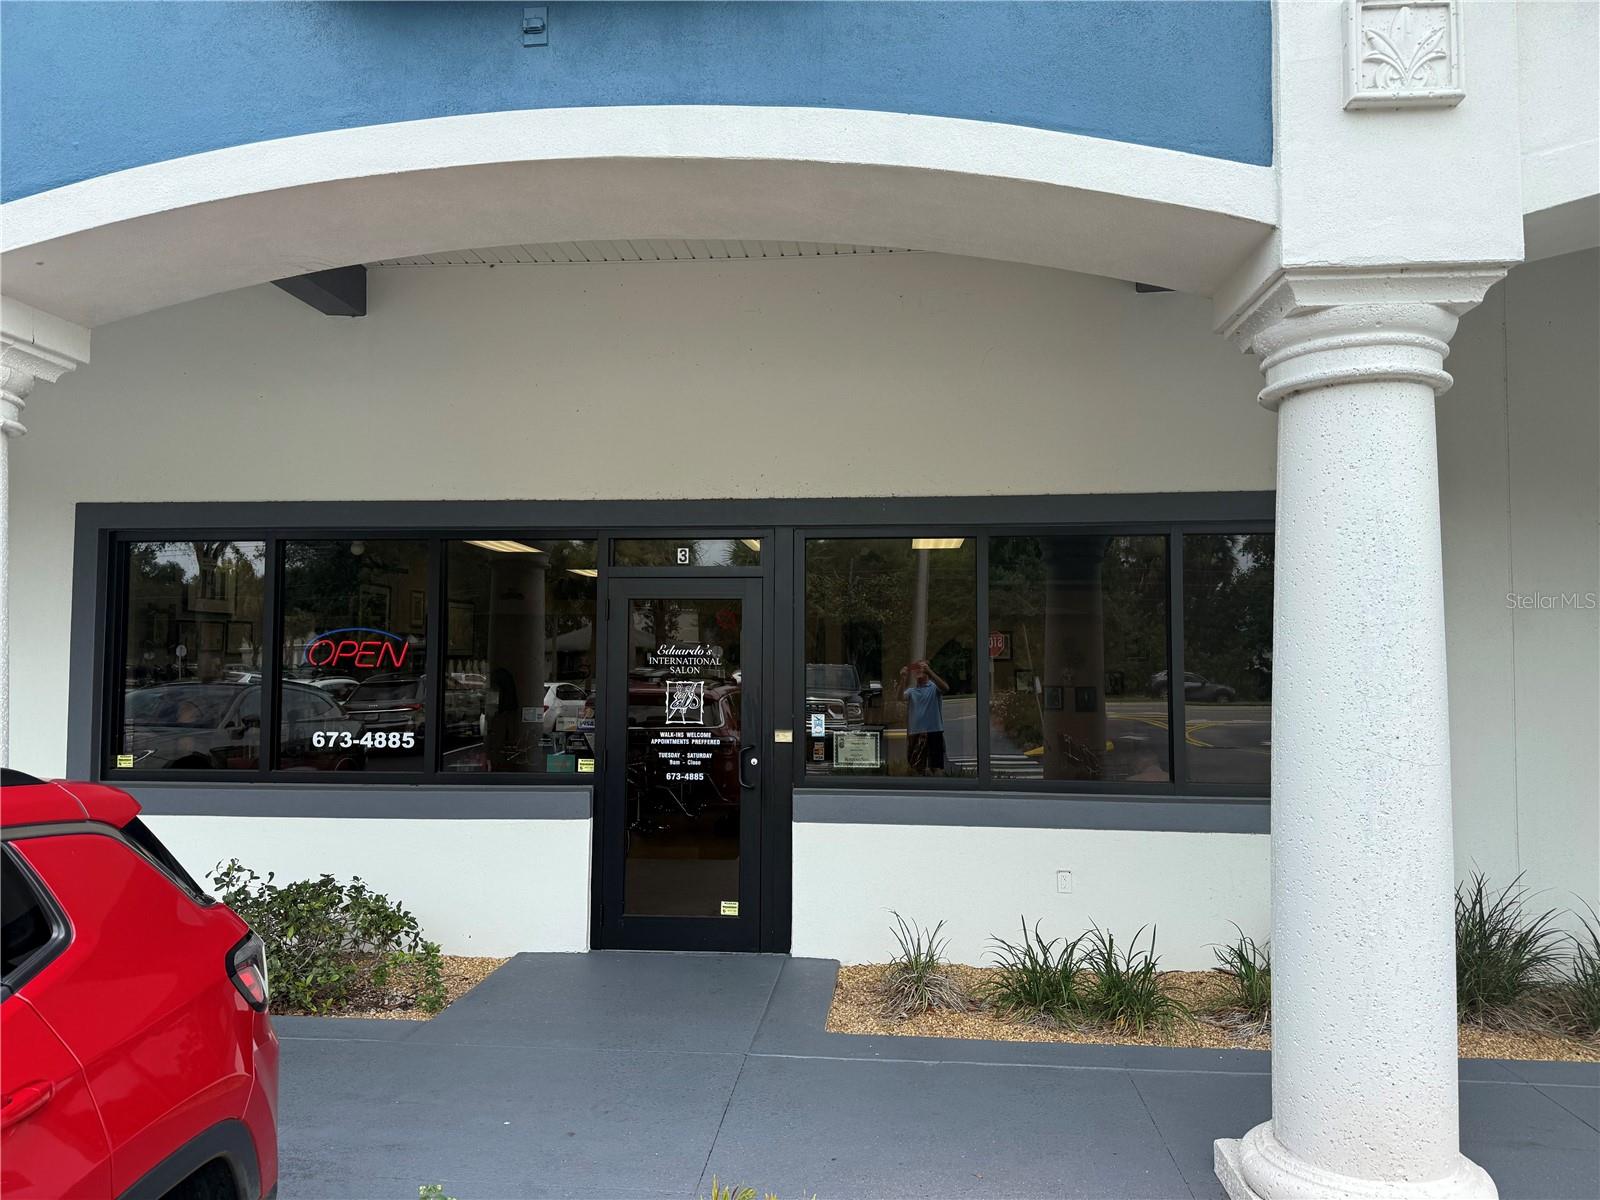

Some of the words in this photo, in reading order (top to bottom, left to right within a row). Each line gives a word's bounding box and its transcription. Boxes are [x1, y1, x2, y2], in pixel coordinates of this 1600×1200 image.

[679, 549, 688, 562] 3
[308, 639, 409, 668] OPEN
[657, 644, 713, 656] Eduardo's
[649, 657, 722, 666] INTERNATIONAL
[669, 666, 700, 674] SALON
[312, 731, 415, 748] 673-4885
